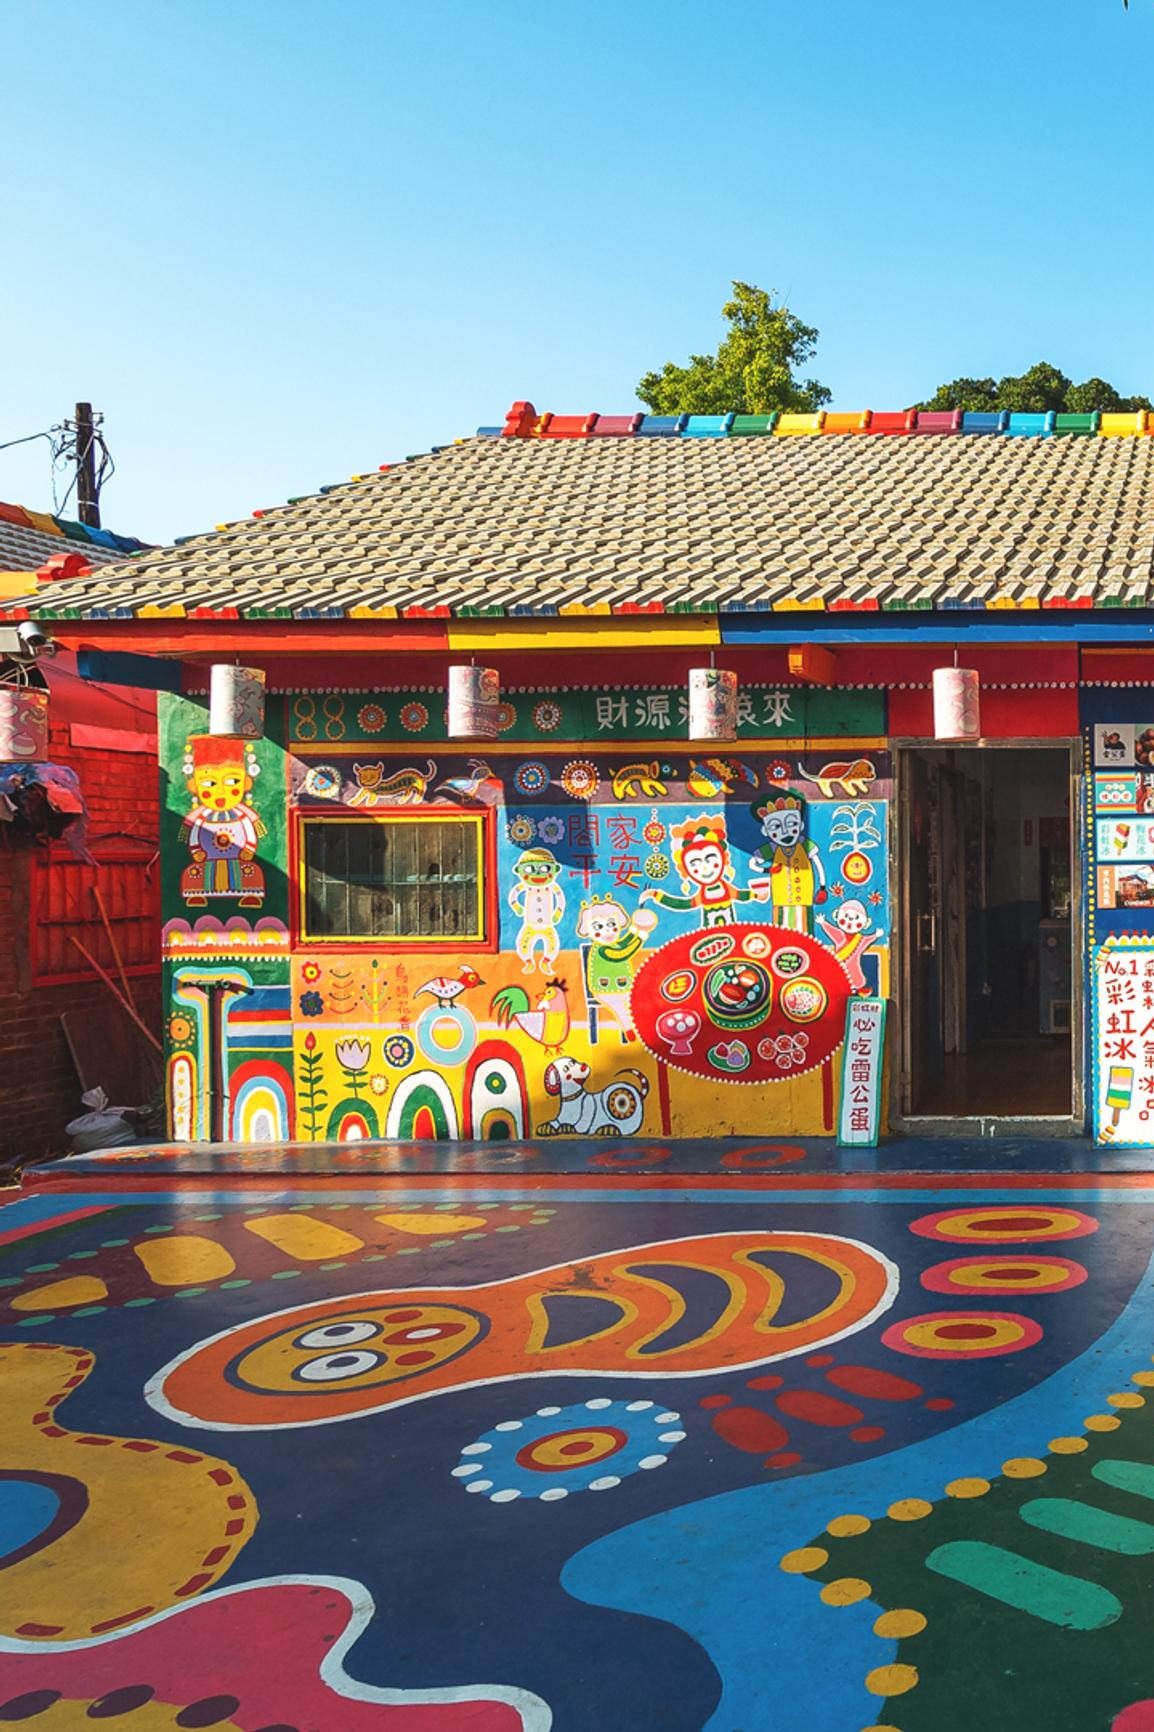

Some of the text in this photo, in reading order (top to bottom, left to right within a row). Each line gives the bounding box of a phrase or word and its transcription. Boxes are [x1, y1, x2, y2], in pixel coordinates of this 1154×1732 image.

[569, 854, 642, 889] 平安
[1104, 978, 1137, 1060] 彩虹冰
[850, 1017, 876, 1132] 必吃雷公蛋
